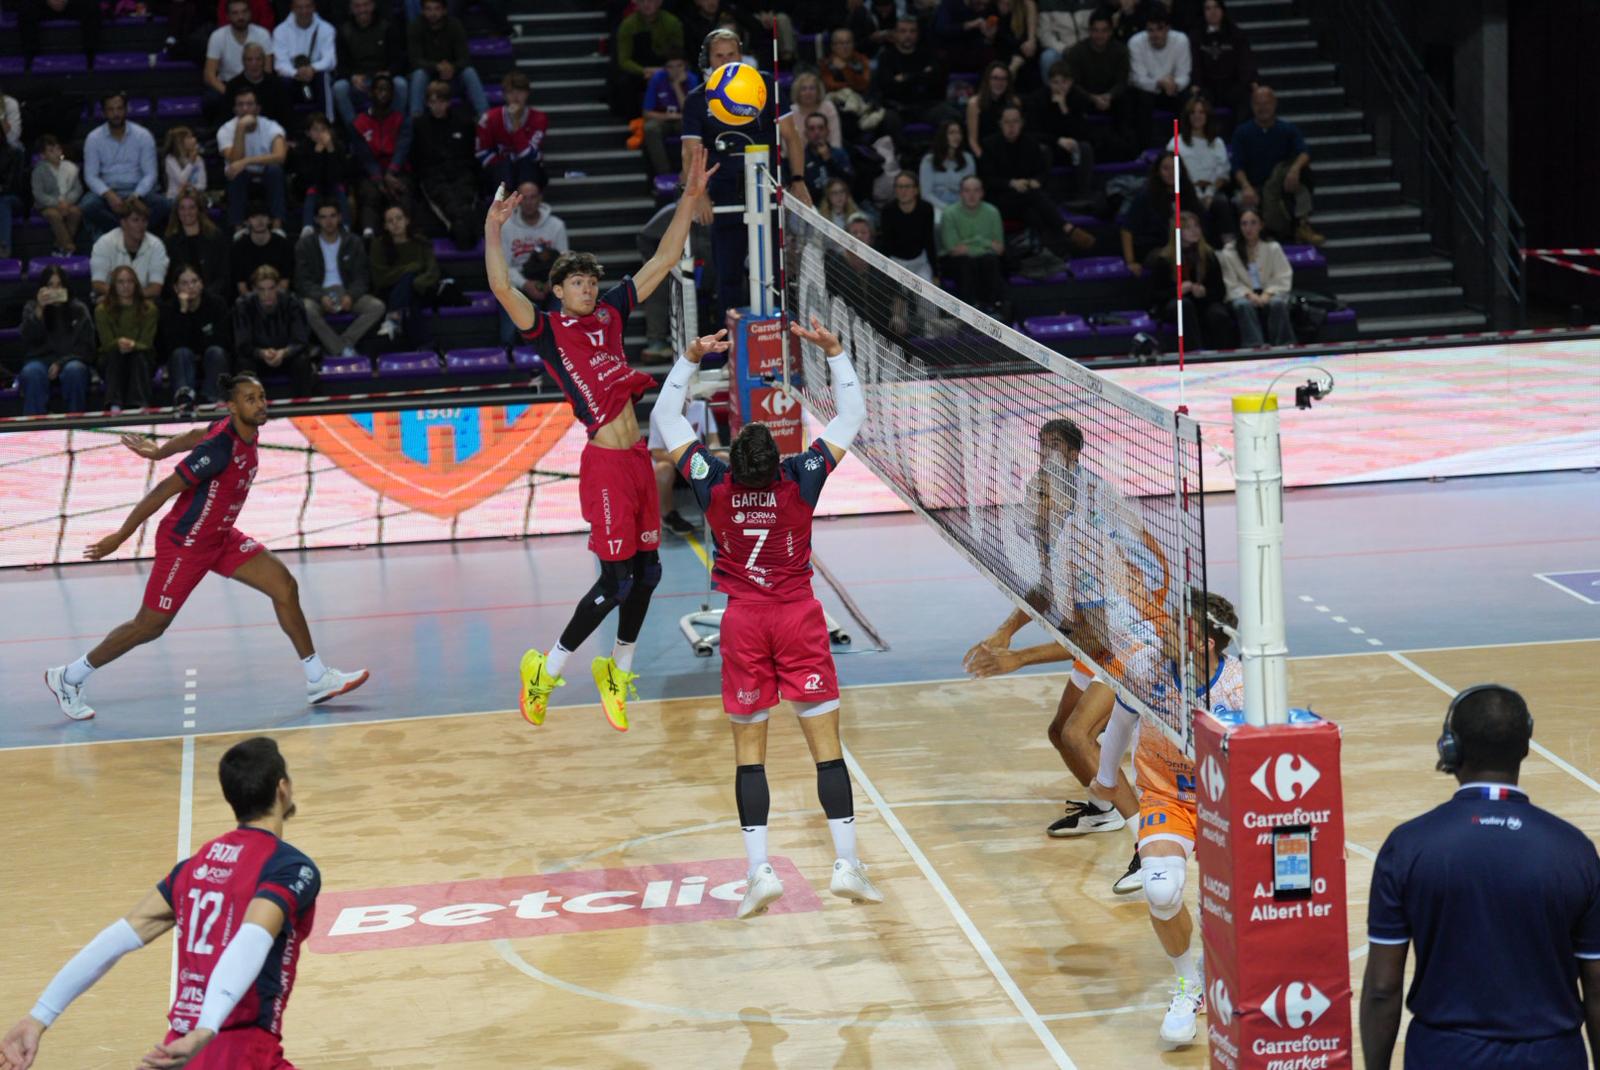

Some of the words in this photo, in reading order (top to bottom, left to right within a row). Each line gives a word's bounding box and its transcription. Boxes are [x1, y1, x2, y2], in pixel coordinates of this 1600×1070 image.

[585, 329, 605, 346] 17
[731, 492, 777, 508] GARCIA
[746, 511, 777, 519] FORMA
[607, 539, 623, 555] 17
[742, 528, 770, 570] 7
[158, 594, 173, 610] 10
[1243, 808, 1331, 829] Carrefour
[1250, 905, 1303, 922] Albert
[1307, 902, 1332, 919] 1er
[187, 888, 225, 955] 12
[1252, 1035, 1341, 1056] Carrefour
